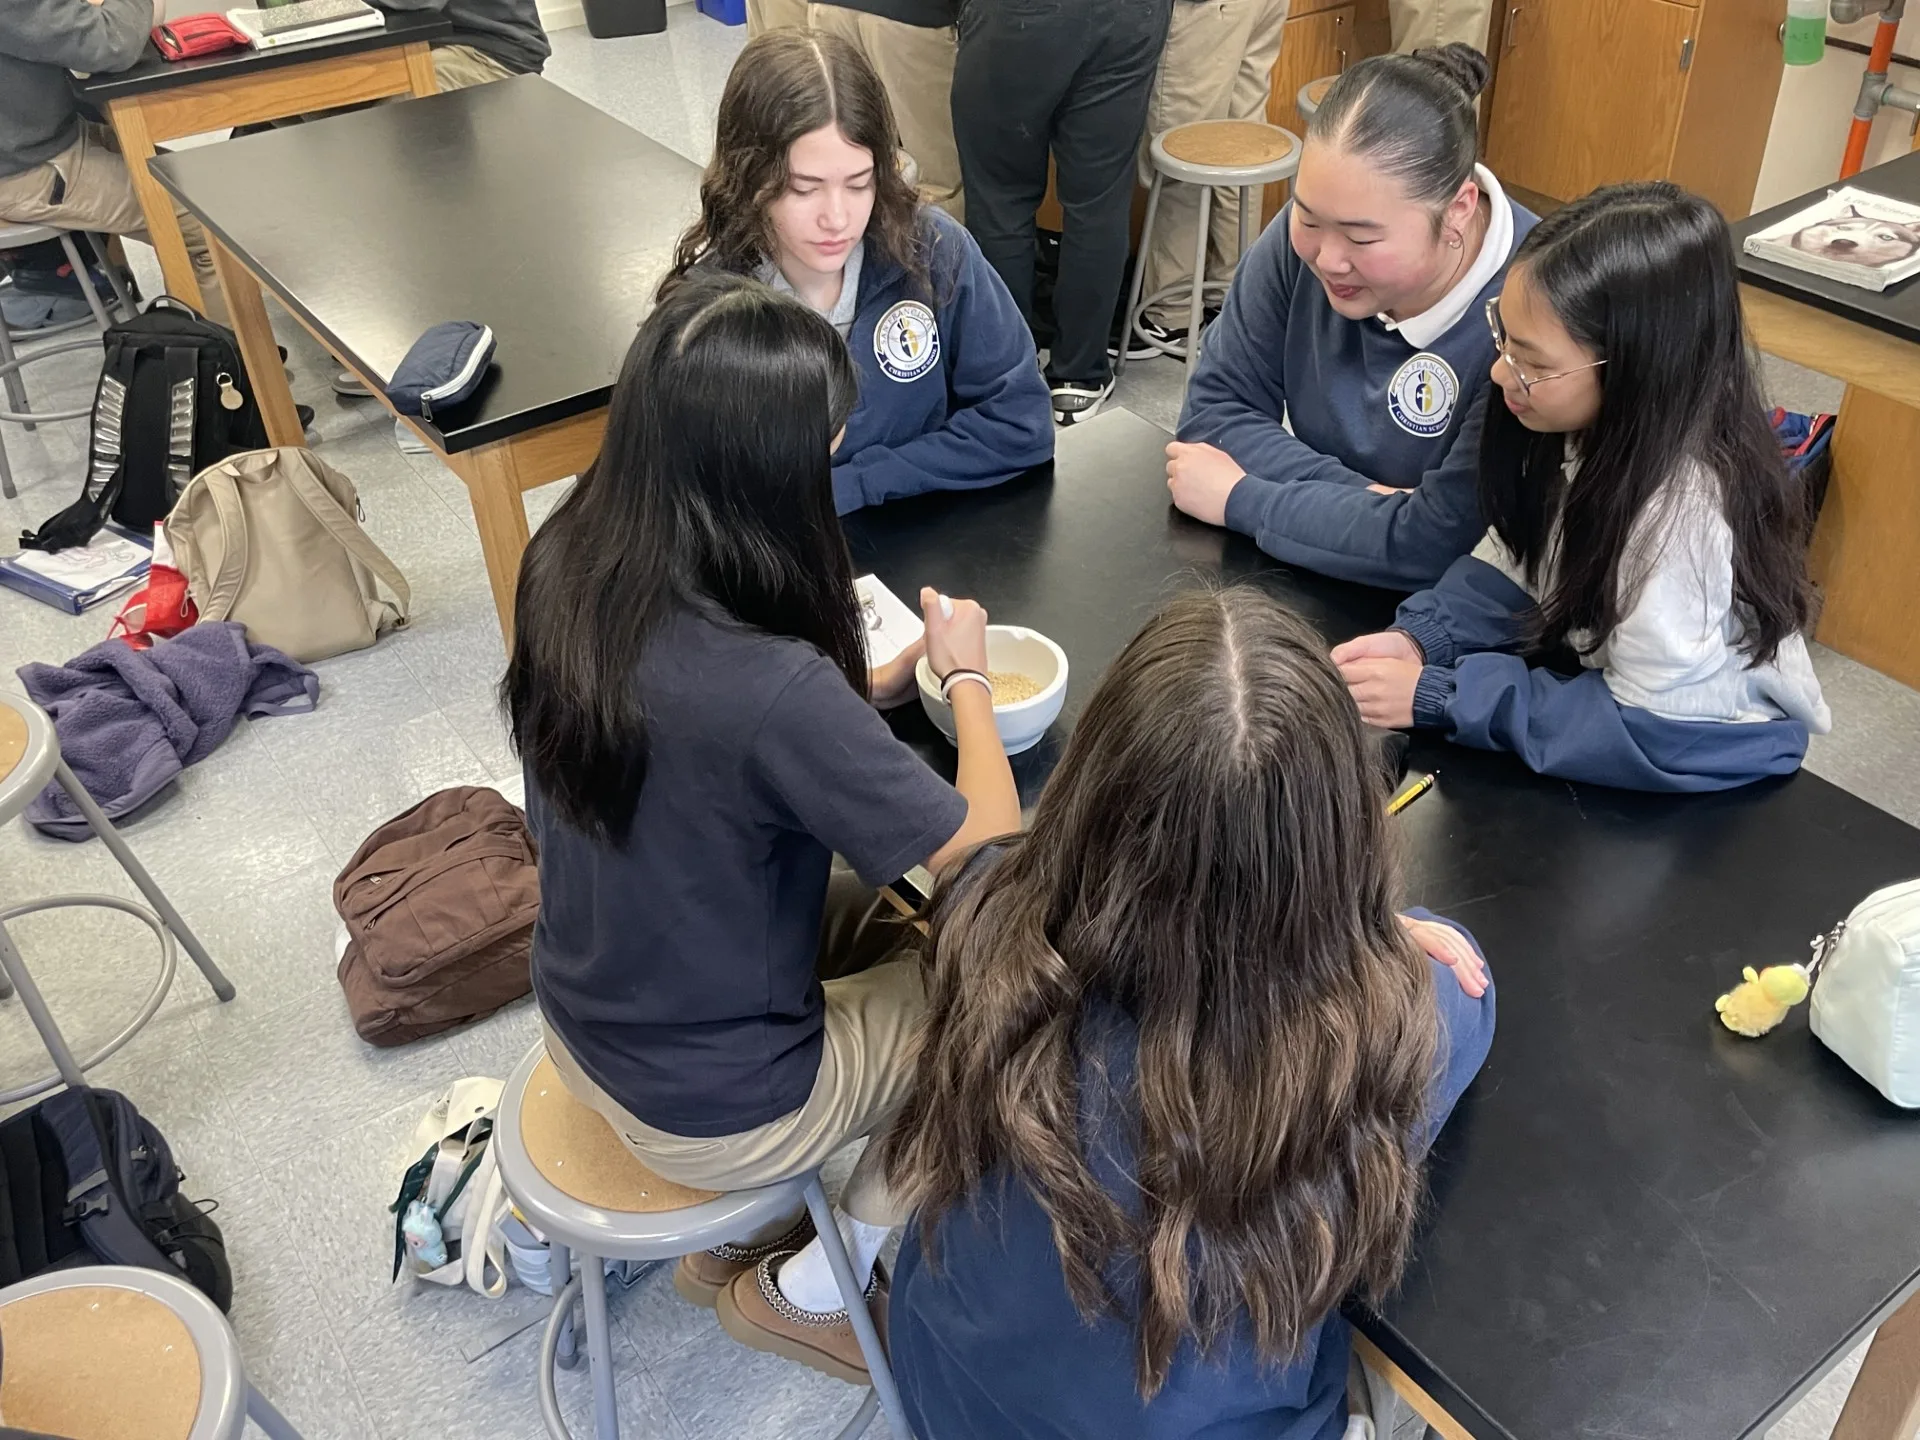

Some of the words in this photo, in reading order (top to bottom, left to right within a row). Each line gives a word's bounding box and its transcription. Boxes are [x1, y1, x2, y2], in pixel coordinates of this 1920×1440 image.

[1748, 243, 1760, 254] 50
[880, 324, 889, 345] SAN
[888, 366, 921, 378] CHRISTIAN
[1397, 370, 1410, 388] SAN
[1411, 361, 1453, 396] FRANCISCO
[1395, 410, 1428, 432] CHRISTIAN
[1412, 414, 1435, 423] TROJANS
